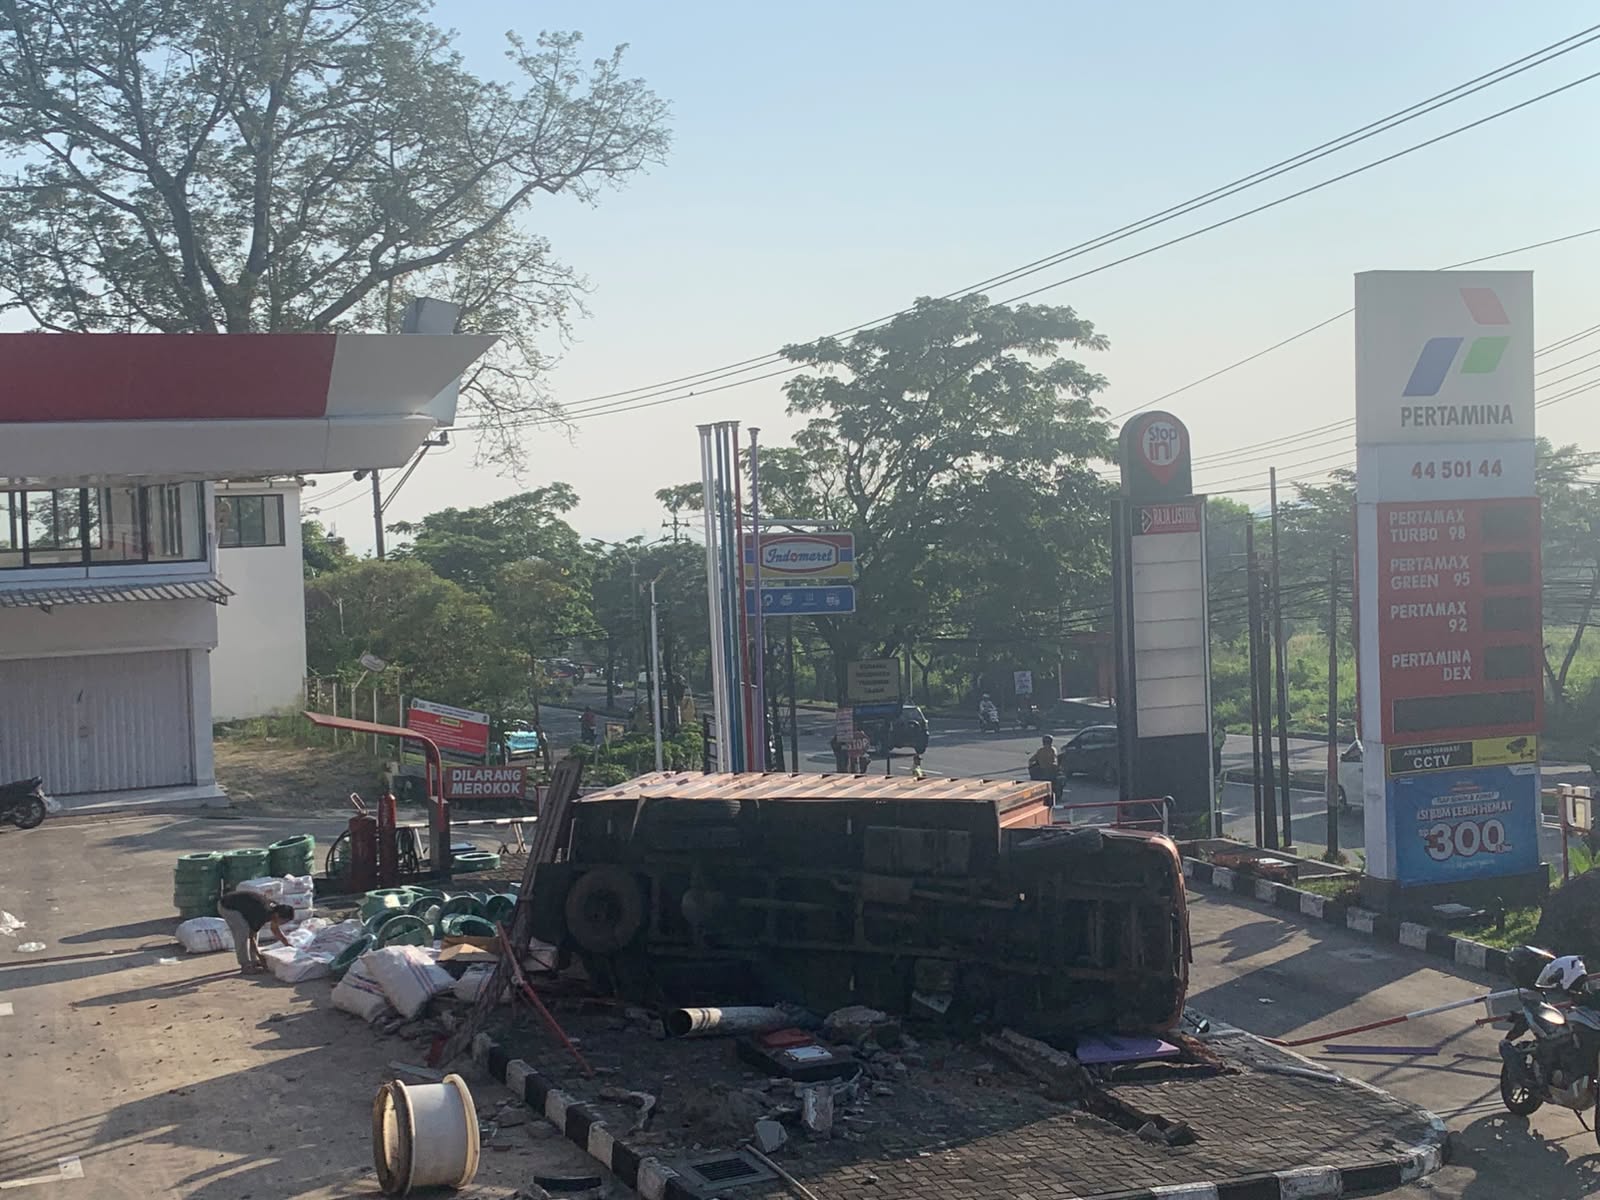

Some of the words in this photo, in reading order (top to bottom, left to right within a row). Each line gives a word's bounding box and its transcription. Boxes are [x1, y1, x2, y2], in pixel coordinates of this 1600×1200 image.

[1401, 404, 1513, 427] PERTAMINA
[1411, 461, 1435, 479] 44
[1441, 460, 1472, 479] 501
[1478, 459, 1503, 477] 44
[1389, 509, 1465, 526] PERTAMAX
[1390, 528, 1438, 543] TURBO
[1449, 526, 1466, 540] 98
[766, 548, 833, 564] Indomaret
[1390, 555, 1469, 573] PERTAMAX
[1391, 574, 1439, 590] GREEN
[1454, 572, 1470, 586] 95
[1391, 601, 1467, 619] PERTAMAX
[1449, 619, 1468, 632] 92
[1392, 649, 1472, 669] PERTAMINA
[1443, 666, 1472, 681] DEX
[1413, 754, 1450, 769] CCTV
[452, 769, 521, 782] DILARANG
[451, 782, 520, 795] MEROKOK
[1452, 805, 1480, 818] LEBIH
[1427, 819, 1505, 861] 300
